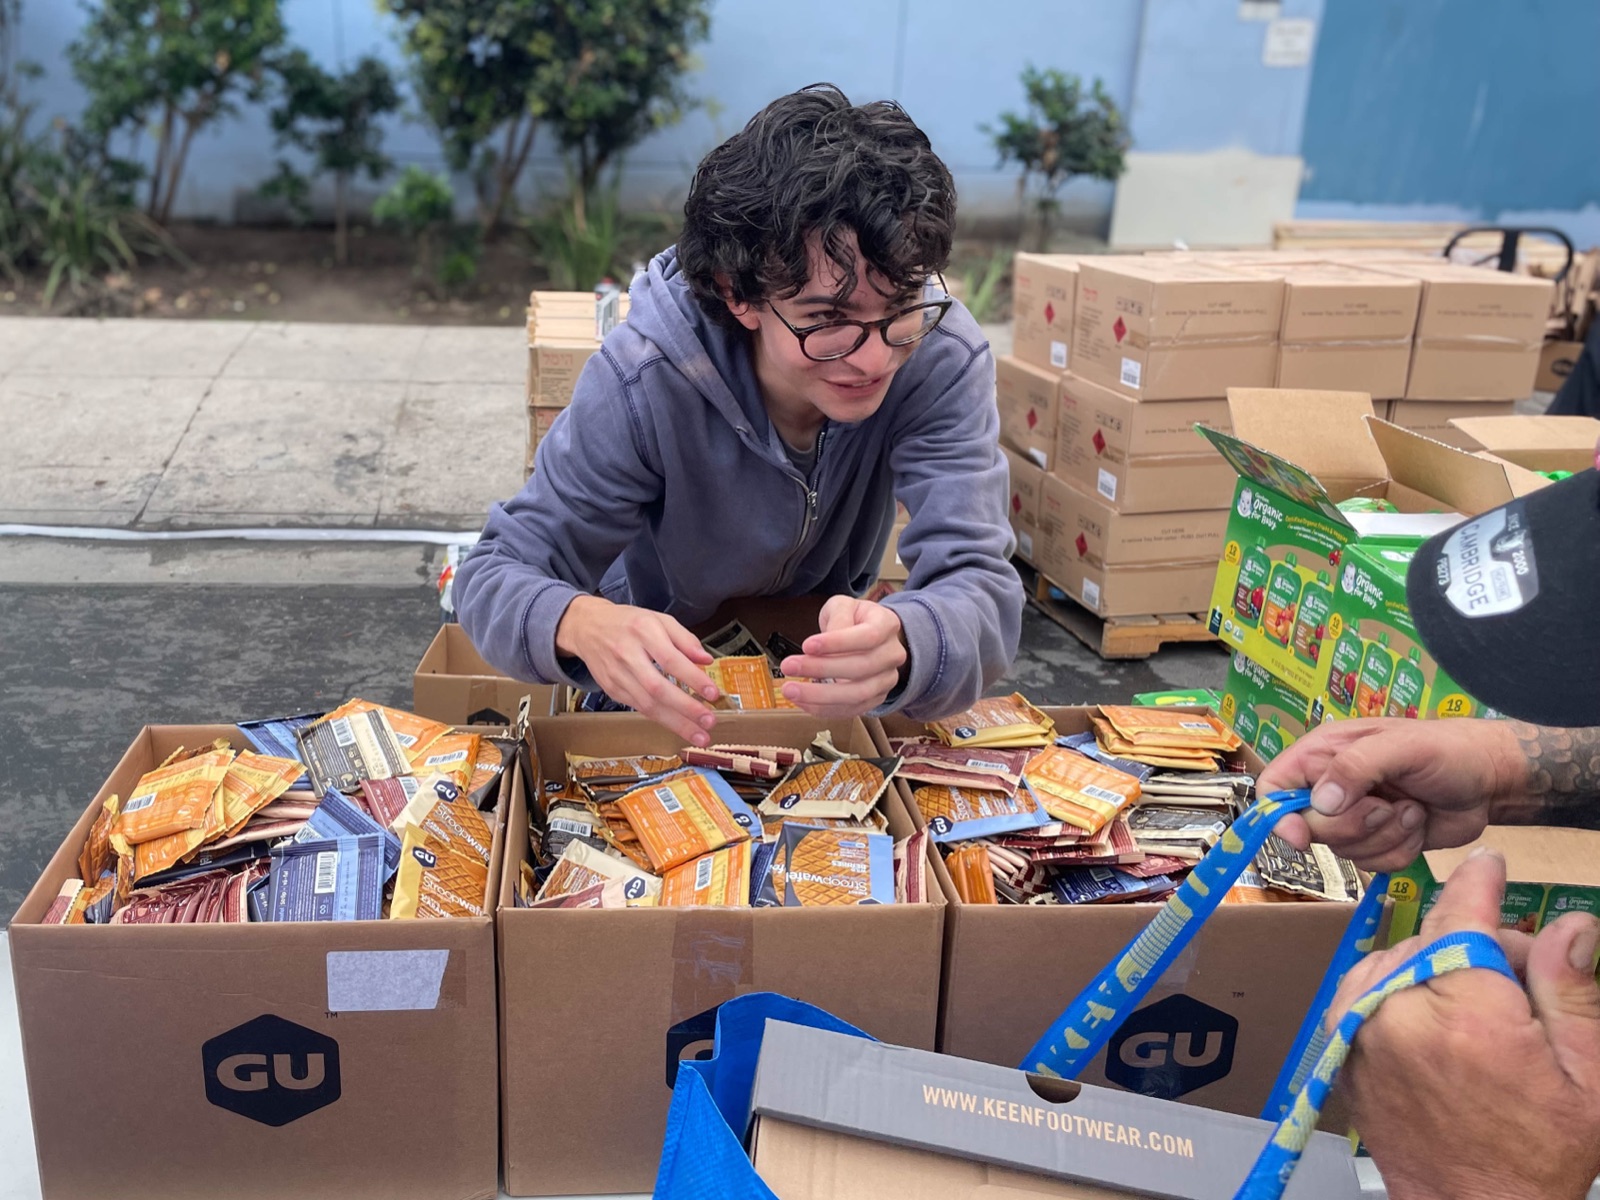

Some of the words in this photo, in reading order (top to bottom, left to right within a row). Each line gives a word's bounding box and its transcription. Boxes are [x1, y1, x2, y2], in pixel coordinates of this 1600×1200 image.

[1253, 498, 1283, 522] Organic
[1261, 515, 1277, 531] Baby
[1460, 523, 1489, 610] CAMBRIDGE
[1511, 549, 1529, 576] 2000
[1356, 574, 1384, 601] Organic
[1362, 592, 1378, 610] Baby
[1445, 699, 1463, 712] 18
[958, 727, 973, 737] GU
[435, 784, 456, 799] GU
[545, 783, 563, 792] GU
[434, 803, 491, 862] Stroopwafe
[934, 817, 947, 833] GU
[414, 850, 435, 864] GU
[627, 880, 642, 899] GU
[785, 871, 868, 892] Stroopwafel
[1391, 881, 1410, 894] 18
[1119, 1031, 1224, 1069] GU
[216, 1053, 326, 1092] GU
[922, 1084, 1194, 1158] WWW.KEENFOOTWEAR.COM
